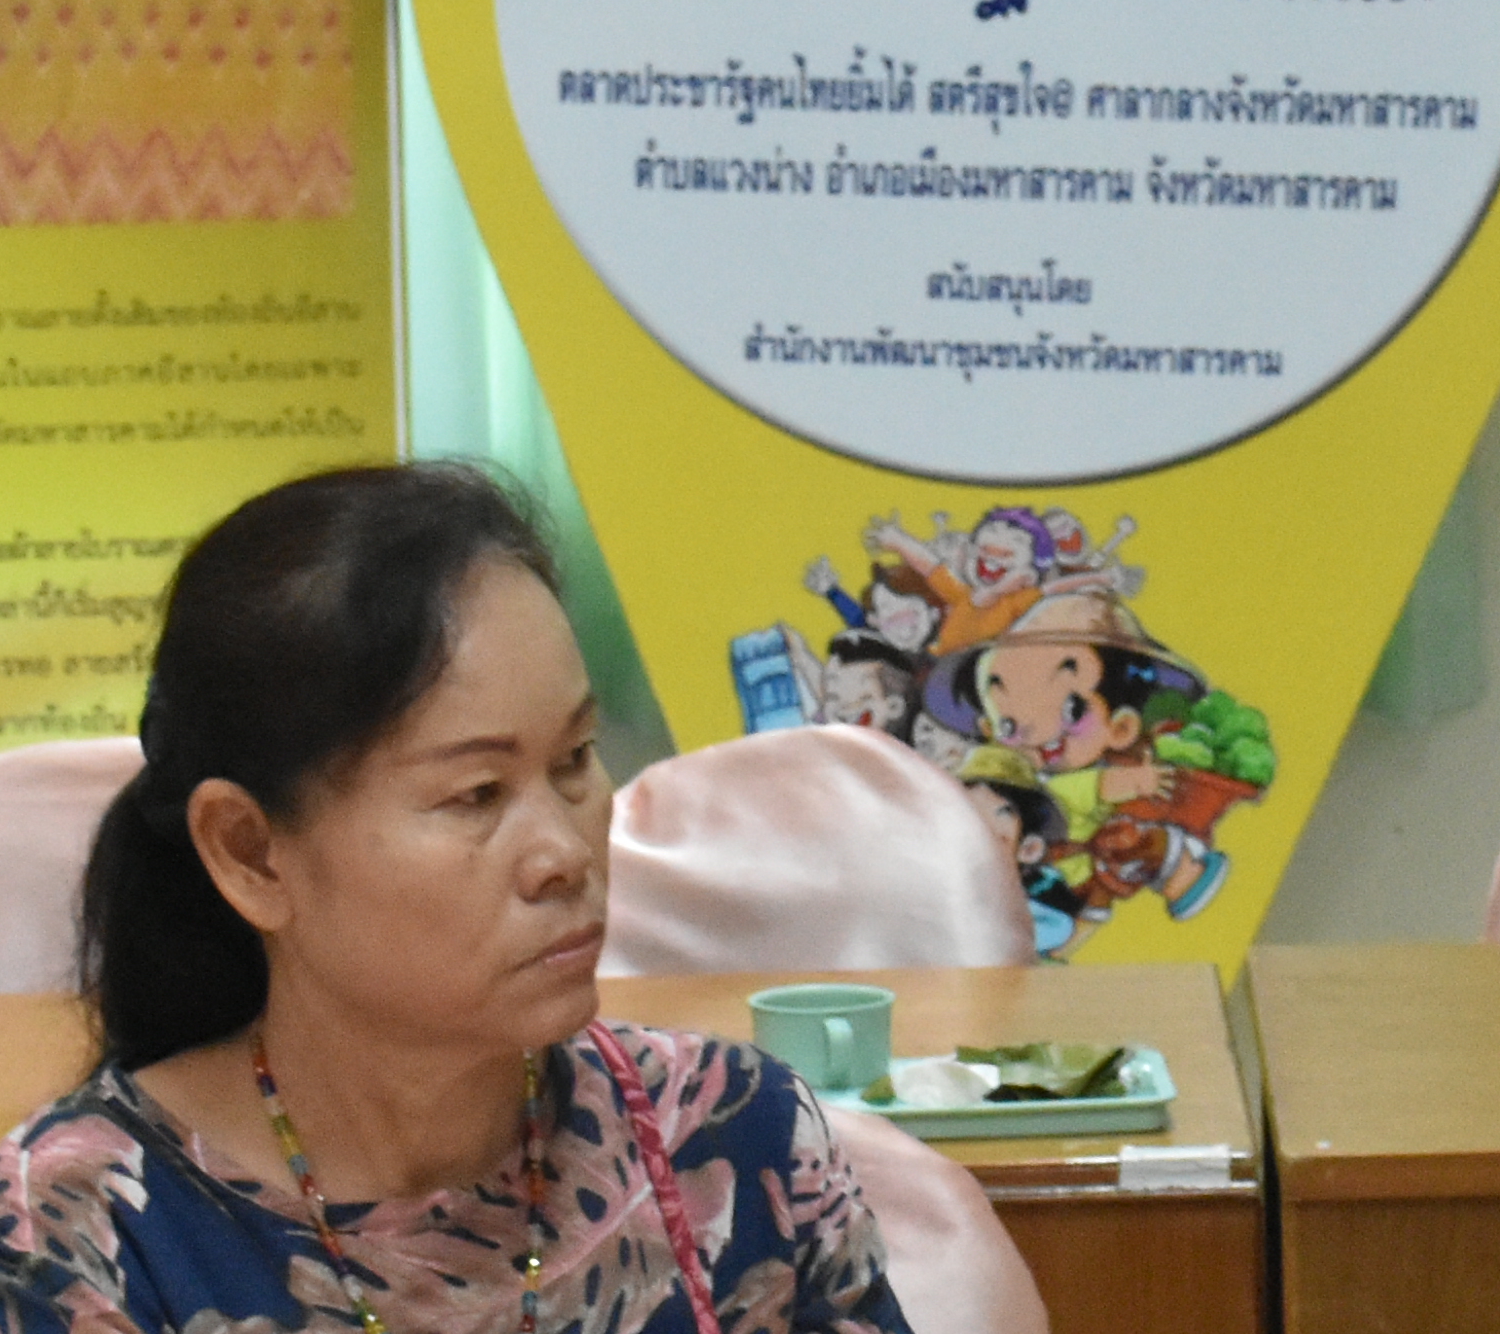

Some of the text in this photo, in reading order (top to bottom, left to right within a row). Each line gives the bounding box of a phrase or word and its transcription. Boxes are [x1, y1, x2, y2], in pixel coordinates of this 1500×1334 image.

[558, 46, 916, 124] ตลาดประชารัฐคนไทยยิ้มได้
[1087, 73, 1480, 129] ศาลากลางจังหวัดมหาสารคาม
[1148, 154, 1398, 210] จังหวัดมหาสารคาม
[927, 258, 1093, 315] สนับสนุนโดย
